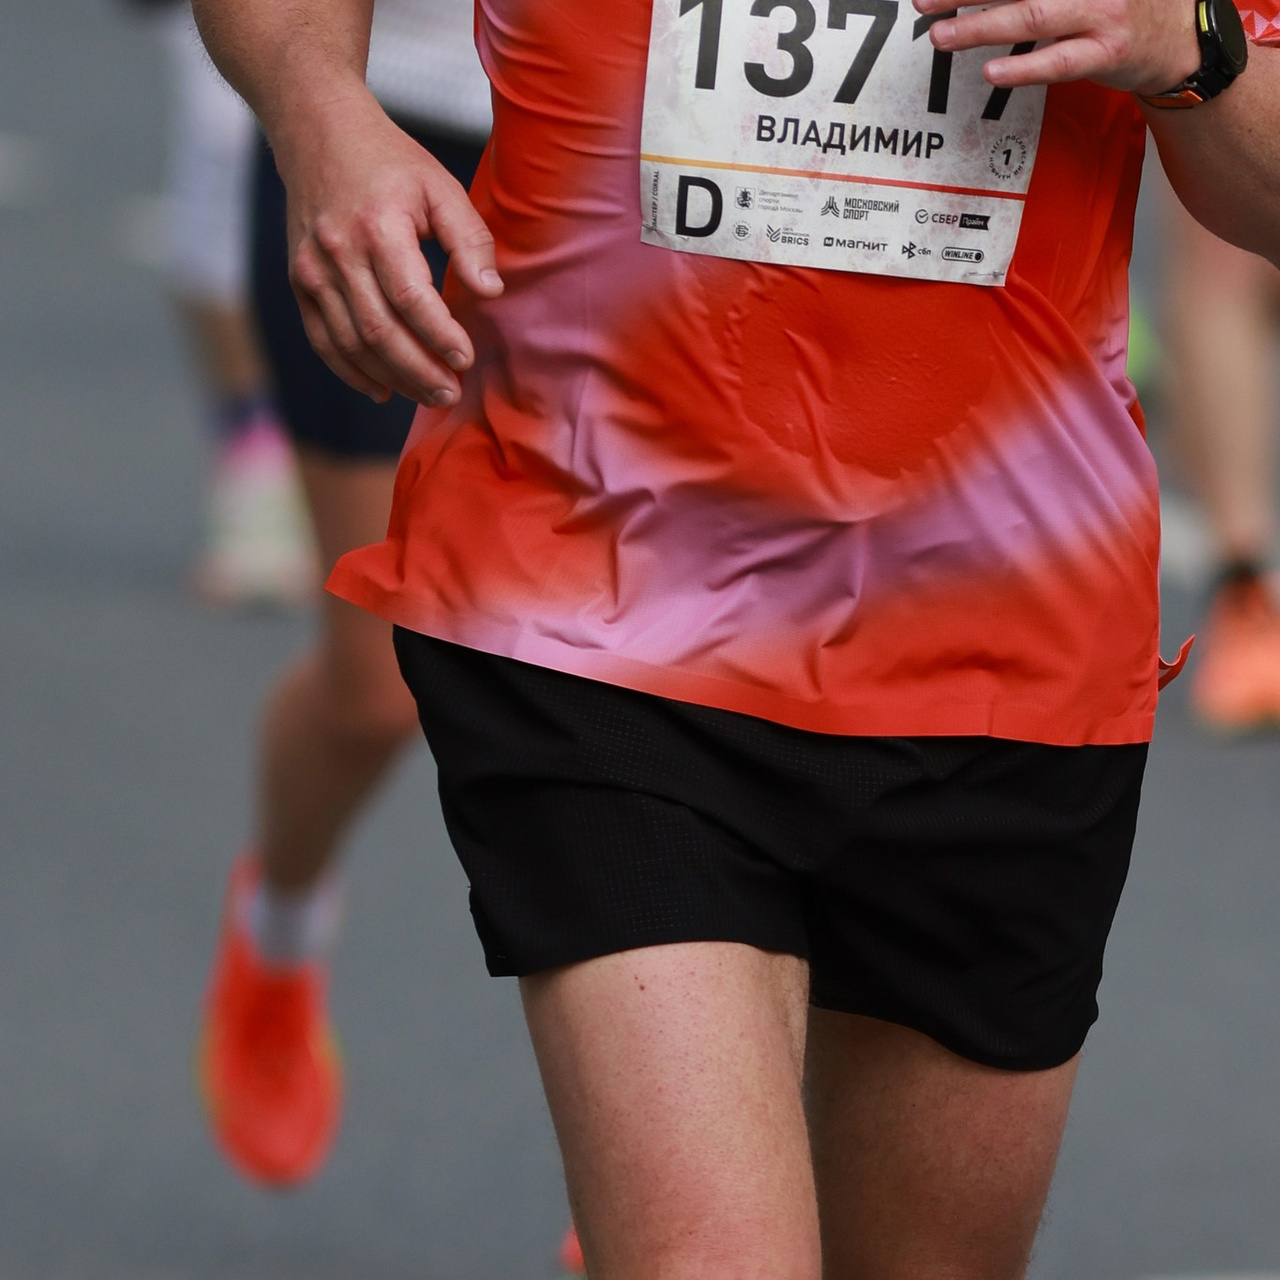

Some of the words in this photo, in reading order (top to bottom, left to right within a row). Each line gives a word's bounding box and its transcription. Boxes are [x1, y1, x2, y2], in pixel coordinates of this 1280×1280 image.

[755, 114, 945, 159] ВЛАДИМИР
[1002, 148, 1012, 166] 1
[675, 174, 724, 238] D
[844, 197, 900, 213] МОСКОВСКИЙ
[843, 208, 870, 221] СПОРТ
[931, 213, 959, 225] СБЕР
[781, 235, 810, 246] BRICS
[835, 238, 888, 252] магнит
[944, 249, 975, 260] WINLINE
